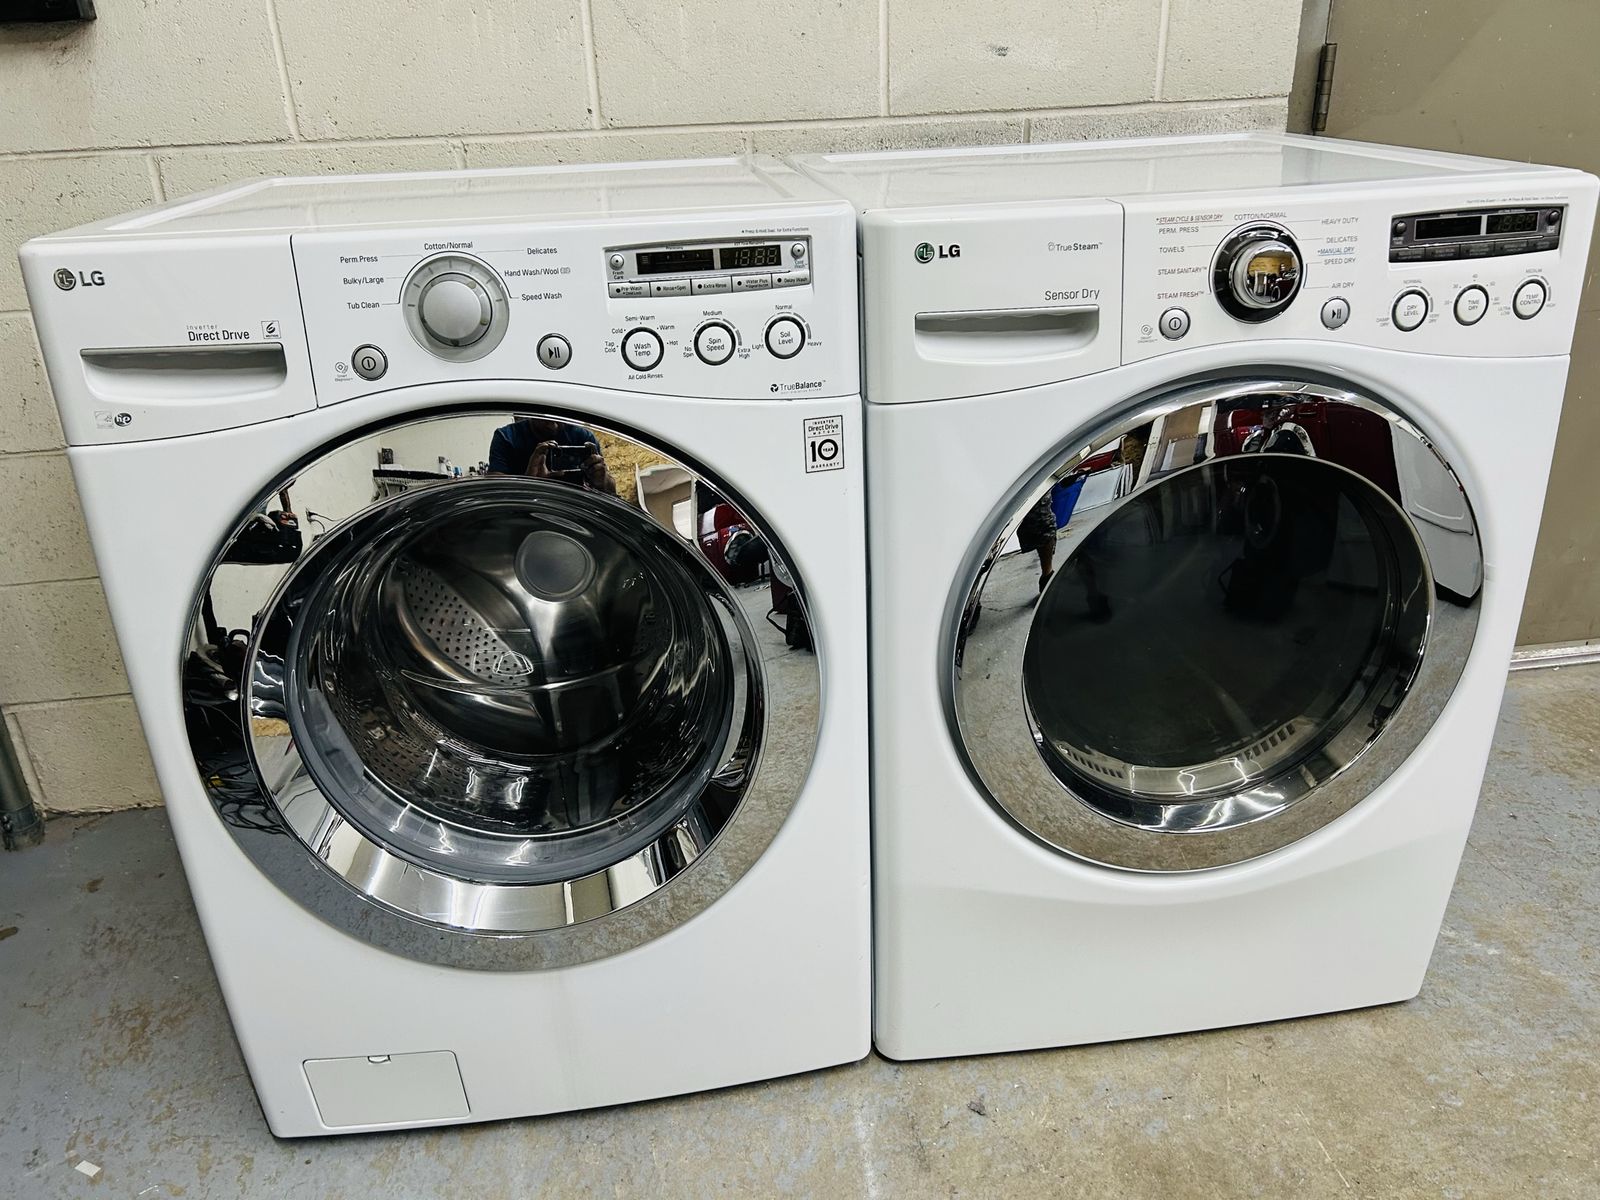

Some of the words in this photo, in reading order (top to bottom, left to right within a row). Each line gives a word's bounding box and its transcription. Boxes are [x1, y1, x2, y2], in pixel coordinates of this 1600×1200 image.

[1326, 236, 1358, 244] DELICATES
[424, 241, 474, 250] Cotton/Normal
[1159, 246, 1185, 254] TOWELS
[526, 247, 558, 255] Delicates
[939, 244, 961, 259] LG
[358, 255, 379, 264] Press
[504, 268, 520, 277] Hand
[521, 266, 560, 276] Wash/Wool
[1157, 268, 1176, 276] STEAM
[80, 270, 106, 287] LG
[343, 275, 385, 286] Bulky/Large
[522, 293, 541, 302] Speed
[542, 291, 562, 300] Wash
[1045, 290, 1079, 301] Sensor
[1081, 288, 1100, 300] Dry
[1157, 292, 1178, 300] STEAM
[347, 302, 360, 310] Tub
[360, 301, 380, 309] Clean
[188, 330, 220, 341] Direct
[222, 329, 250, 341] Drive
[706, 344, 725, 352] Speed
[810, 438, 839, 462] 10
